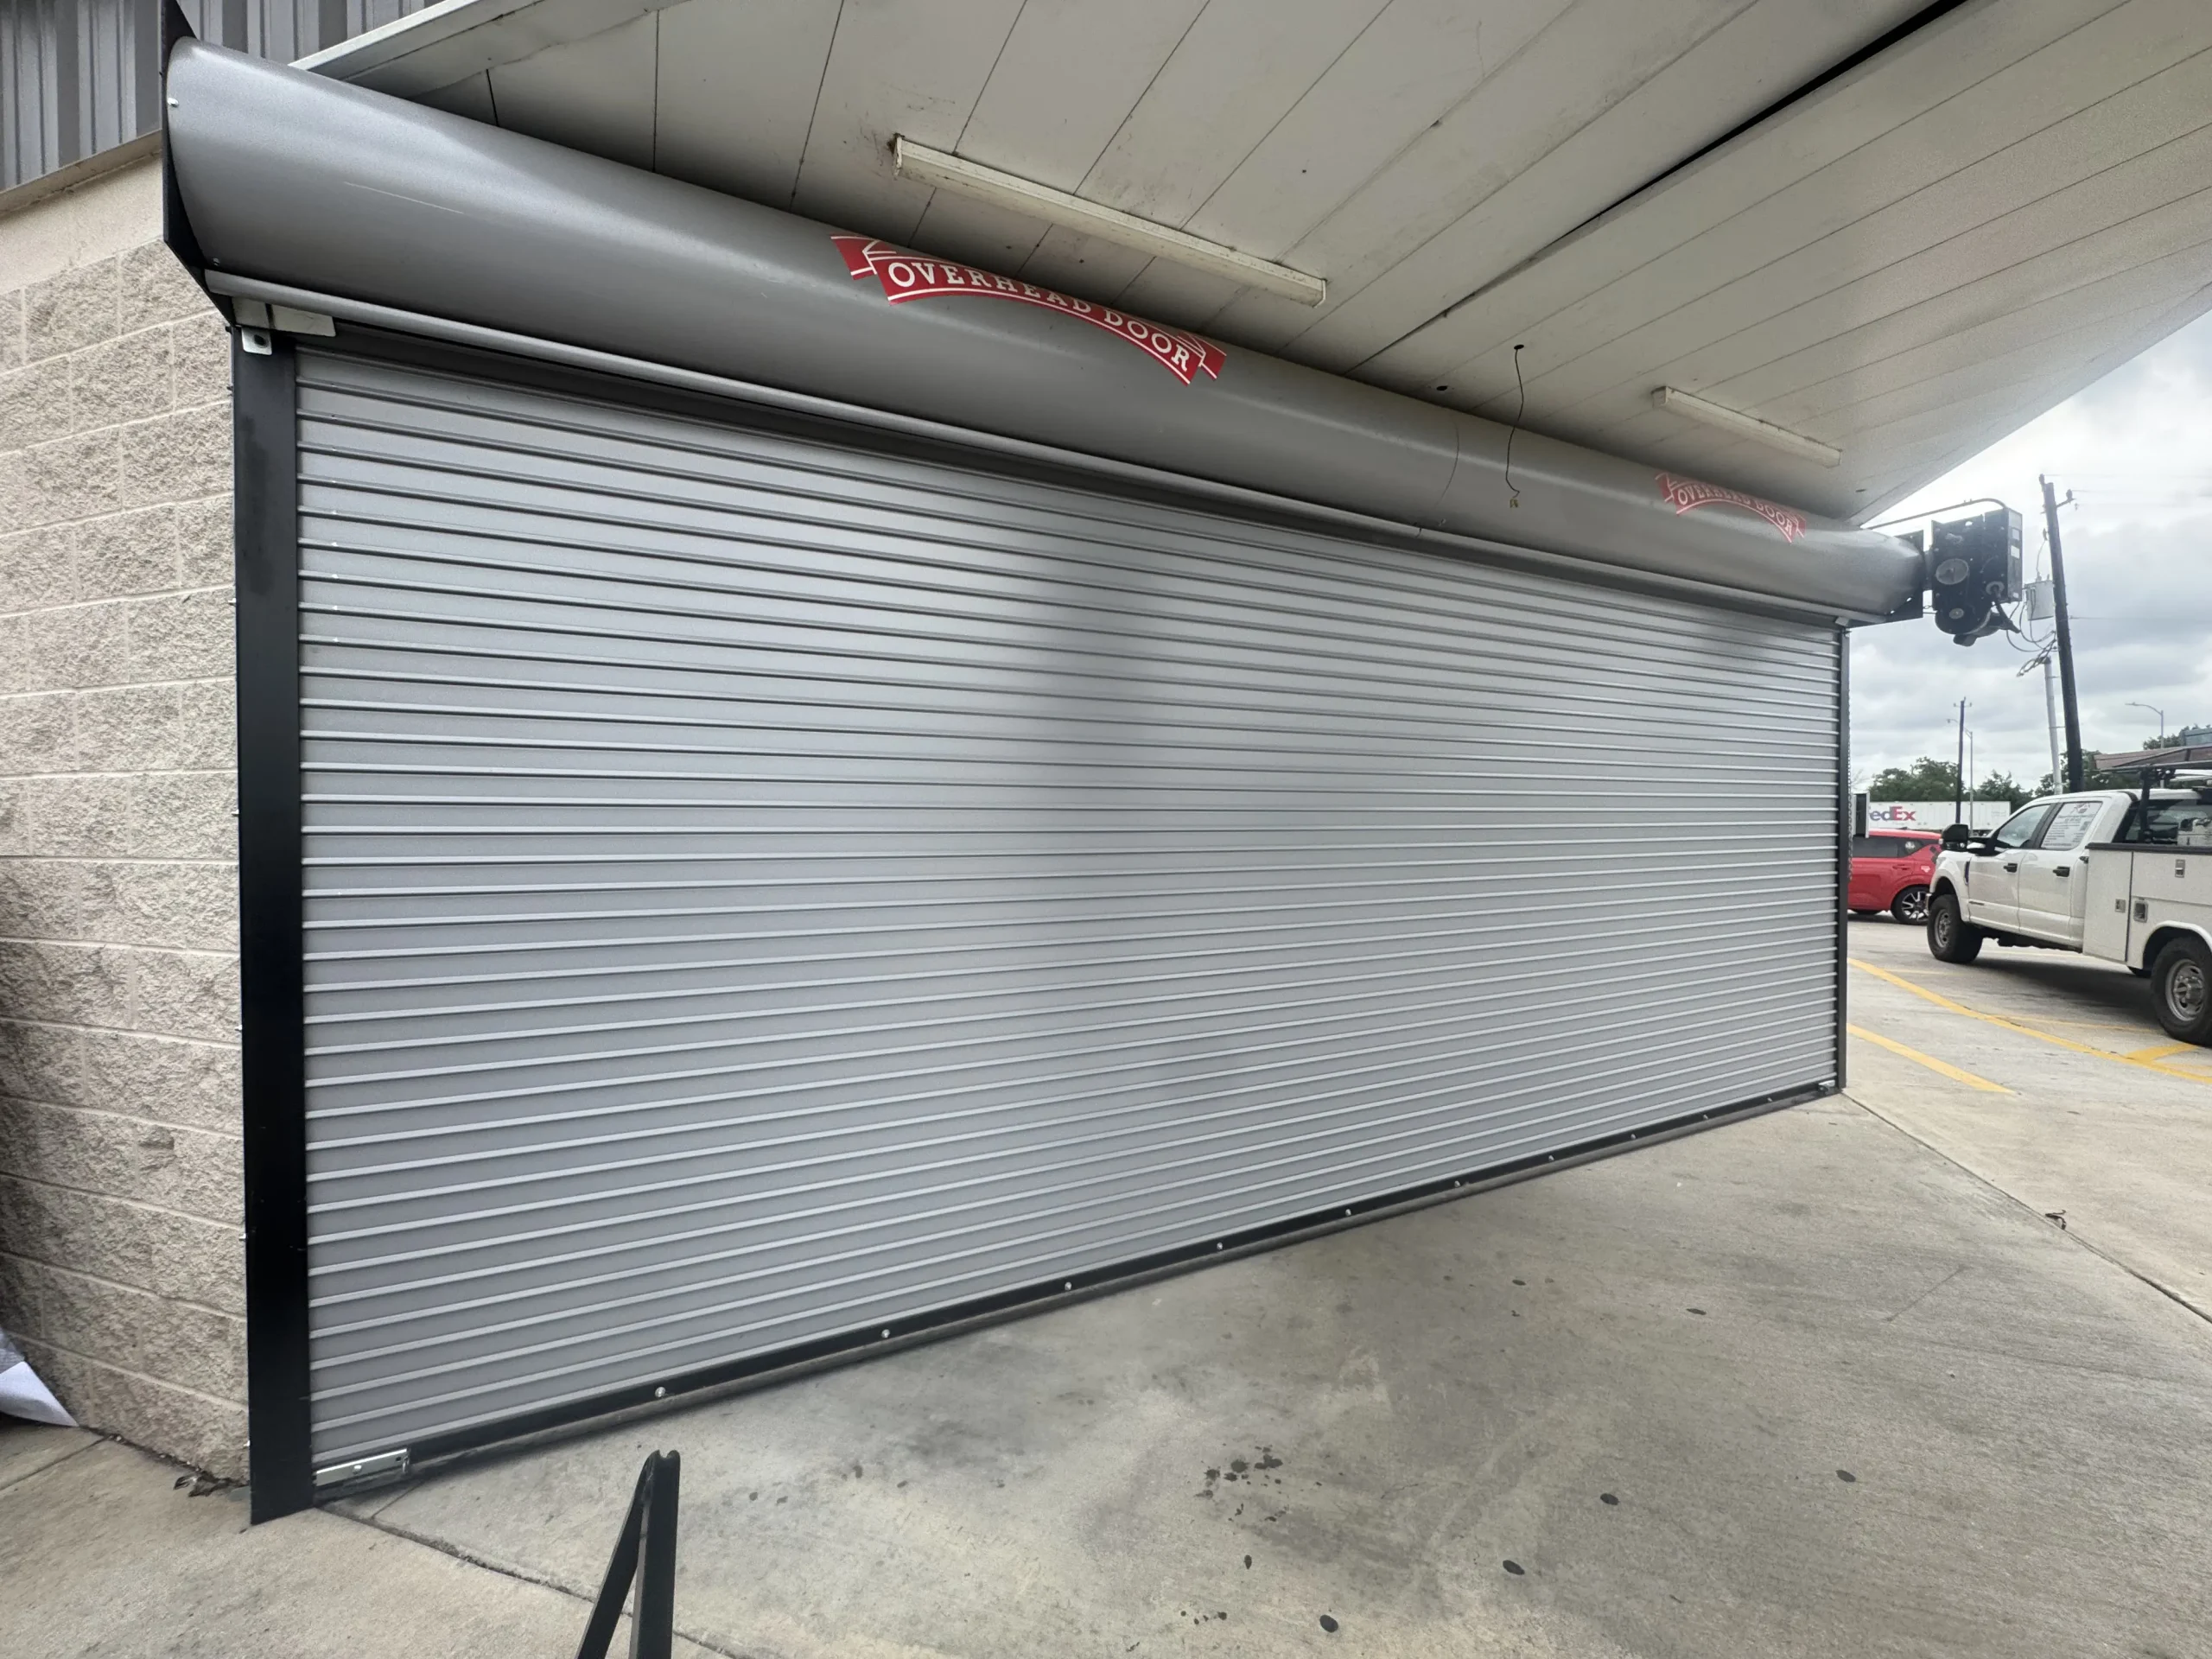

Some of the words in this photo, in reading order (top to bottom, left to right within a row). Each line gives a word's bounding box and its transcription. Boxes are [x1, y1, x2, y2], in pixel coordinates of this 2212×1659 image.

[887, 261, 1092, 314] OVERHEAD
[1103, 309, 1191, 372] DOOR
[1869, 806, 1916, 821] edEx
